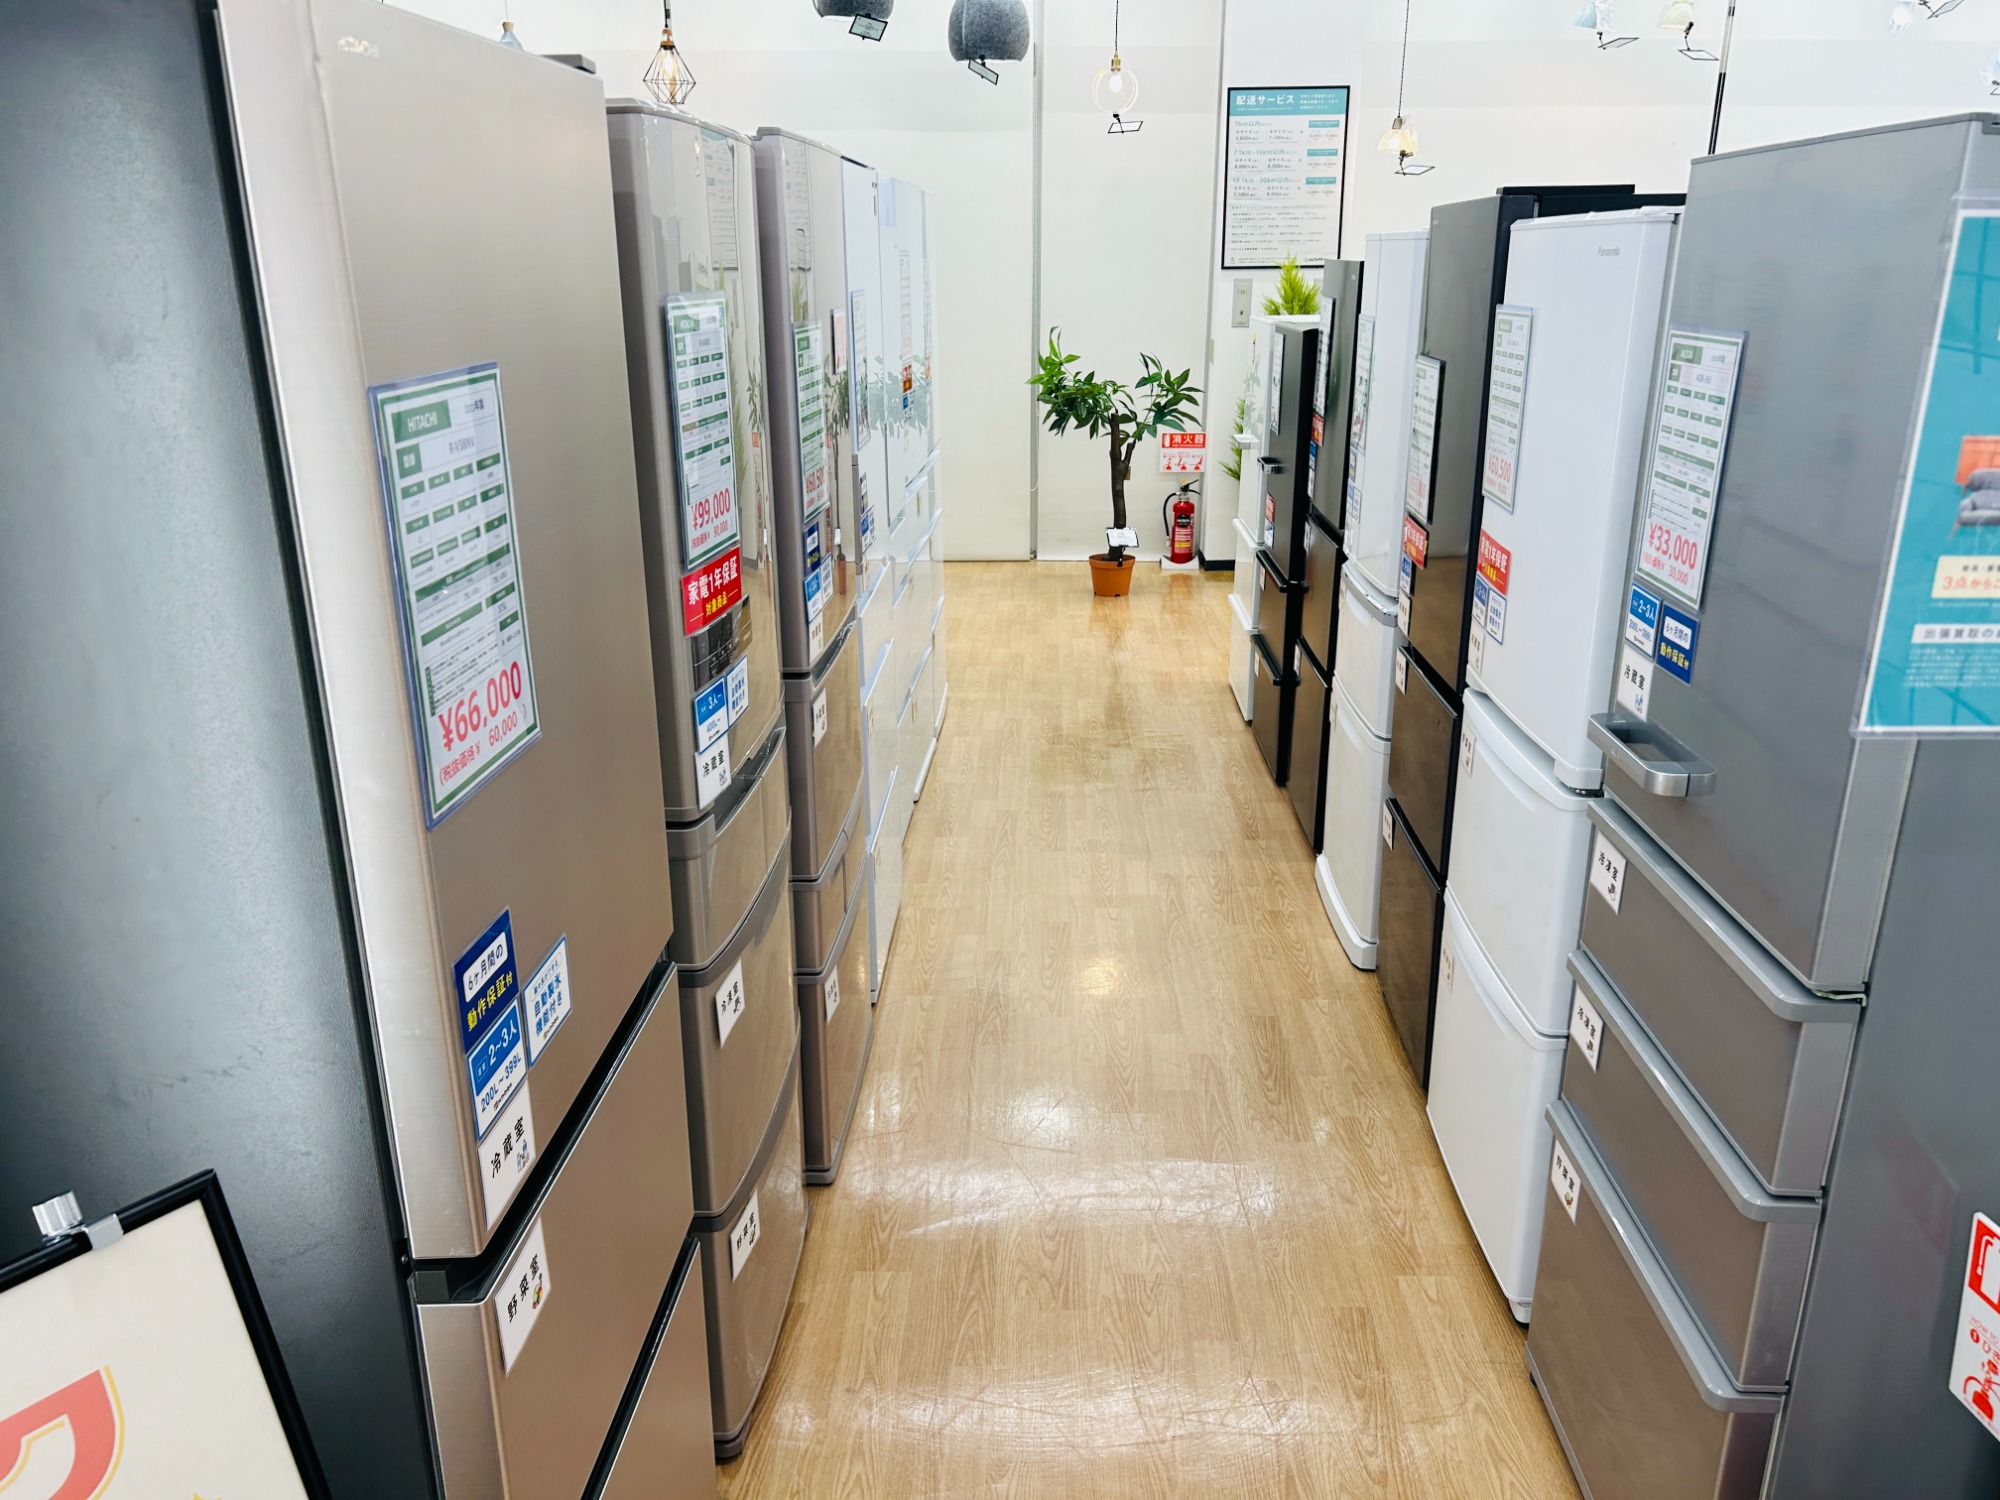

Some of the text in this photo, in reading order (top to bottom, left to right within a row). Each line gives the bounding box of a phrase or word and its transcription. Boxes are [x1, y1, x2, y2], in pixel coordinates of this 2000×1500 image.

[1236, 94, 1294, 105] 配送サービス
[407, 411, 439, 432] HITACHI
[1172, 434, 1204, 444] 消火器
[691, 488, 731, 530] ¥99,000
[1649, 521, 1698, 570] ¥33,000
[687, 555, 738, 605] 家電1年保証
[438, 661, 522, 752] ¥66,000
[488, 710, 518, 747] 60,000
[466, 970, 513, 1032] 動作保証付
[490, 1115, 526, 1179] 冷蔵室
[507, 1253, 541, 1324] 野菜室
